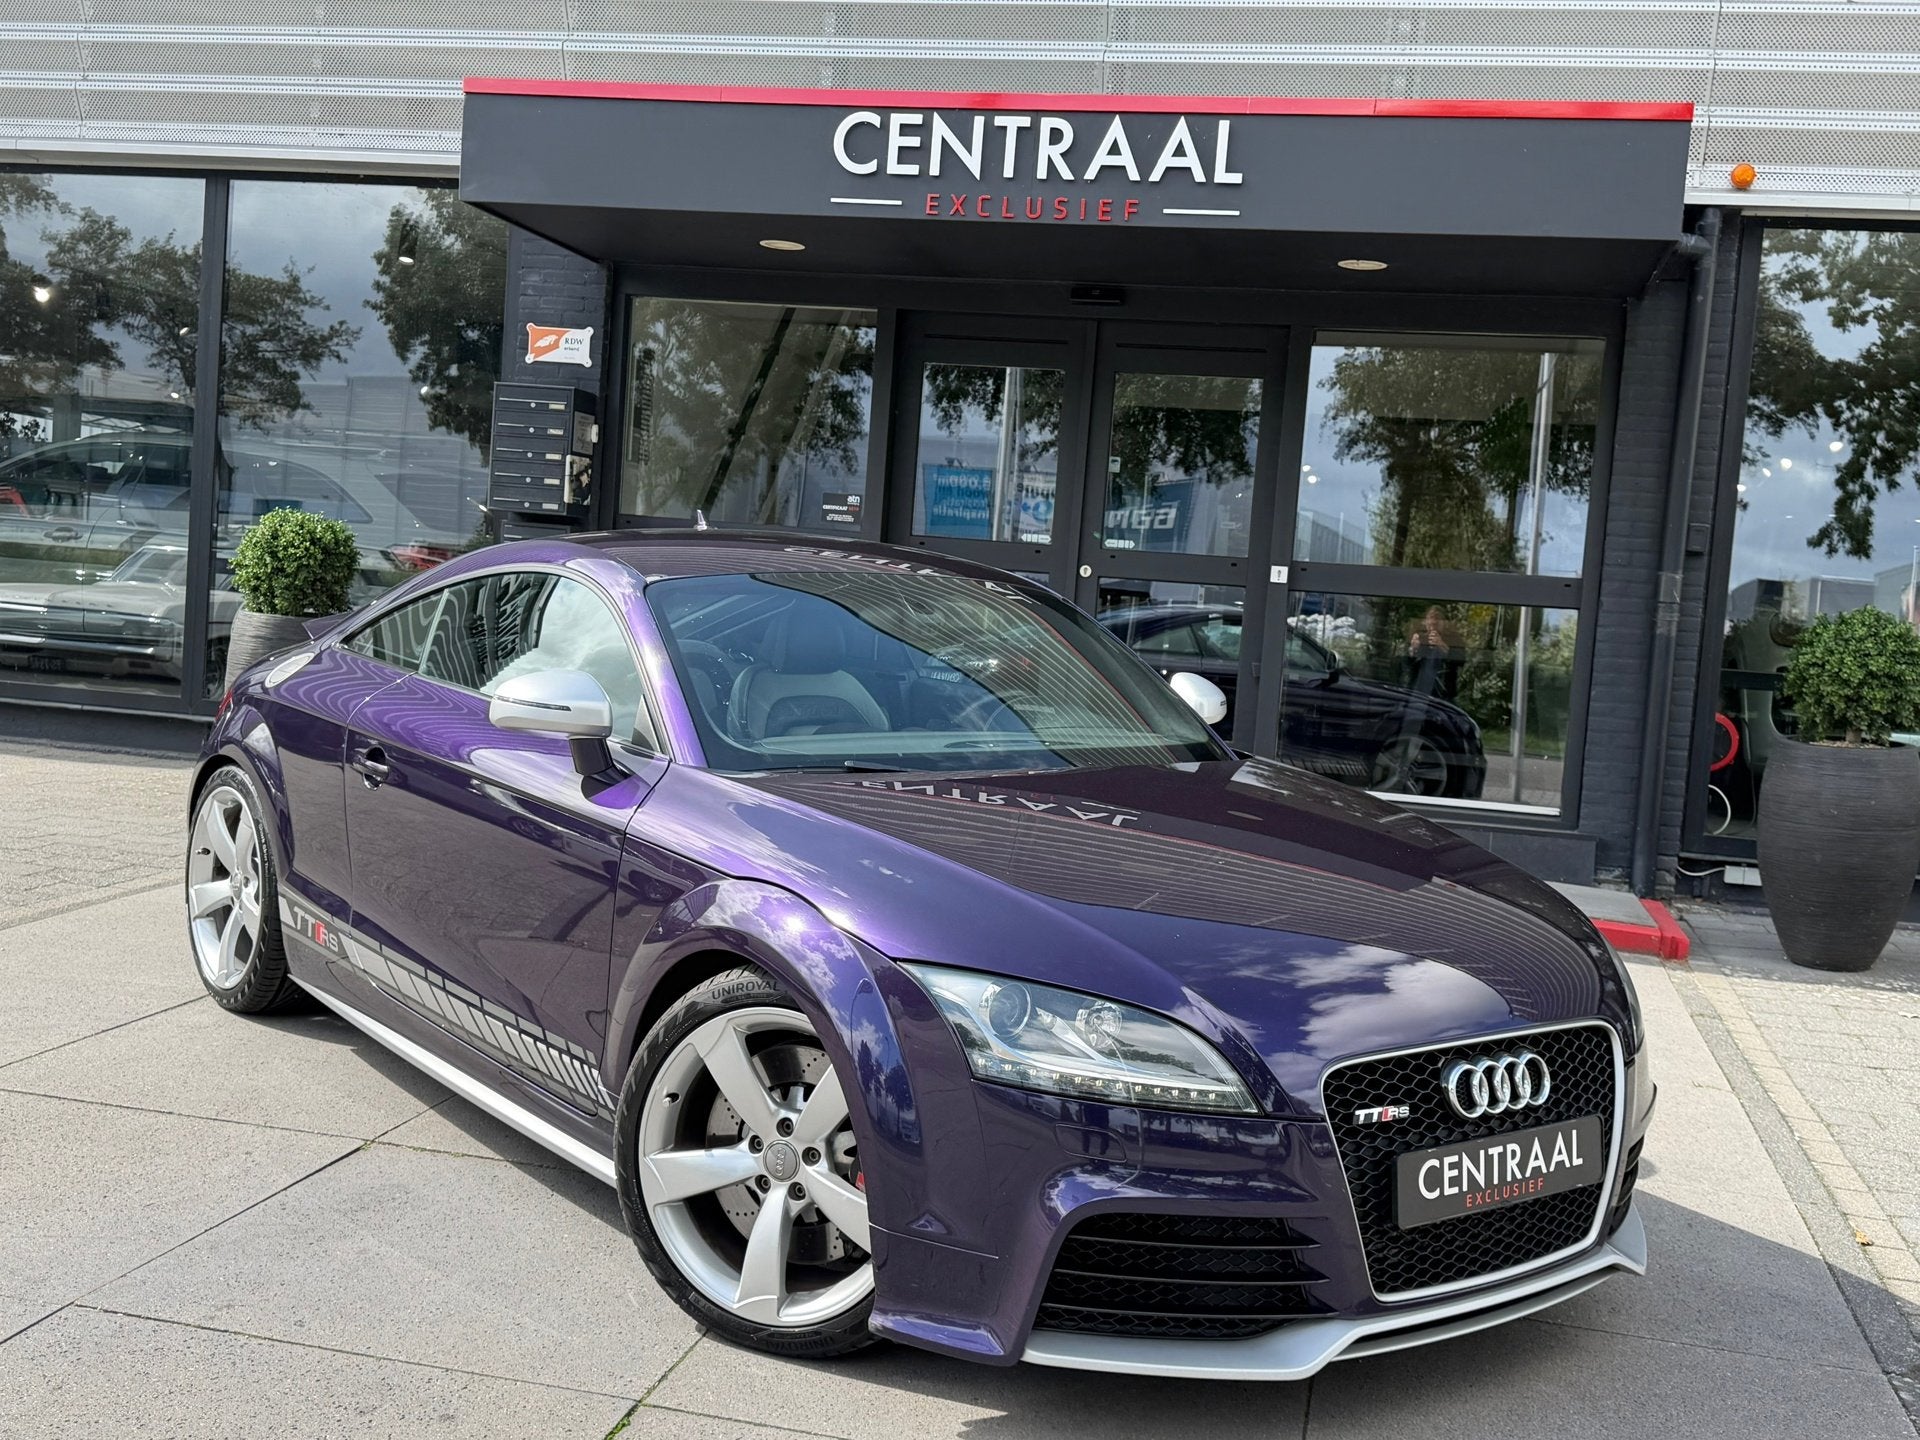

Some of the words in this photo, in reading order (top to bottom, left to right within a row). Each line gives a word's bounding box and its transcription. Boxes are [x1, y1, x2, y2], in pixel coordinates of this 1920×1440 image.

[832, 111, 1243, 185] CENTRAAL
[925, 193, 1141, 222] EXCLUSIEF
[564, 337, 584, 345] RDW
[711, 981, 781, 1000] UNIROYAL
[1418, 1129, 1584, 1200] CENTRAAL
[1465, 1177, 1546, 1208] EXCLUSIEF
